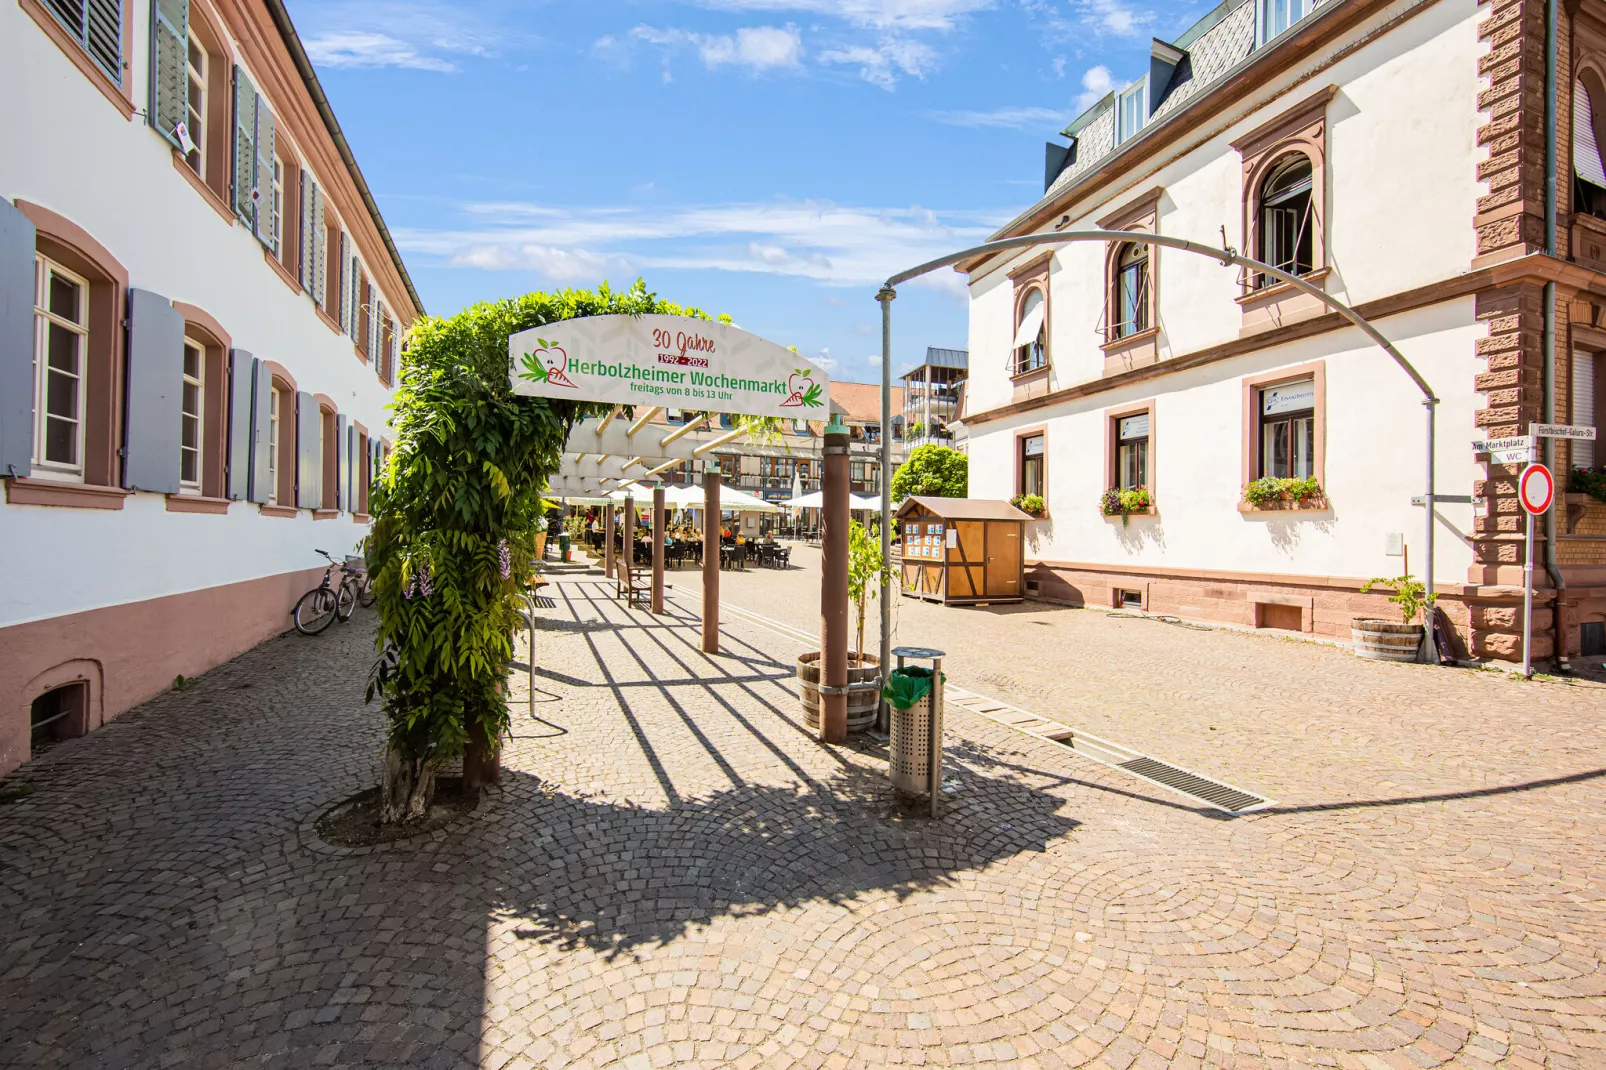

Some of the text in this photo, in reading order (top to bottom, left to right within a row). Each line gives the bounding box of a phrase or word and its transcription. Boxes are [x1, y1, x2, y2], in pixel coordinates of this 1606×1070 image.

[652, 328, 716, 356] 30 Jahre
[659, 354, 679, 364] 1992
[687, 357, 707, 368] 2022
[568, 358, 787, 395] Herbolzheimer Wochenmarkt
[630, 382, 733, 400] freitags von 8 bis 13 Uhr
[1472, 438, 1524, 451] Am Marktplatz
[1506, 452, 1523, 461] WC
